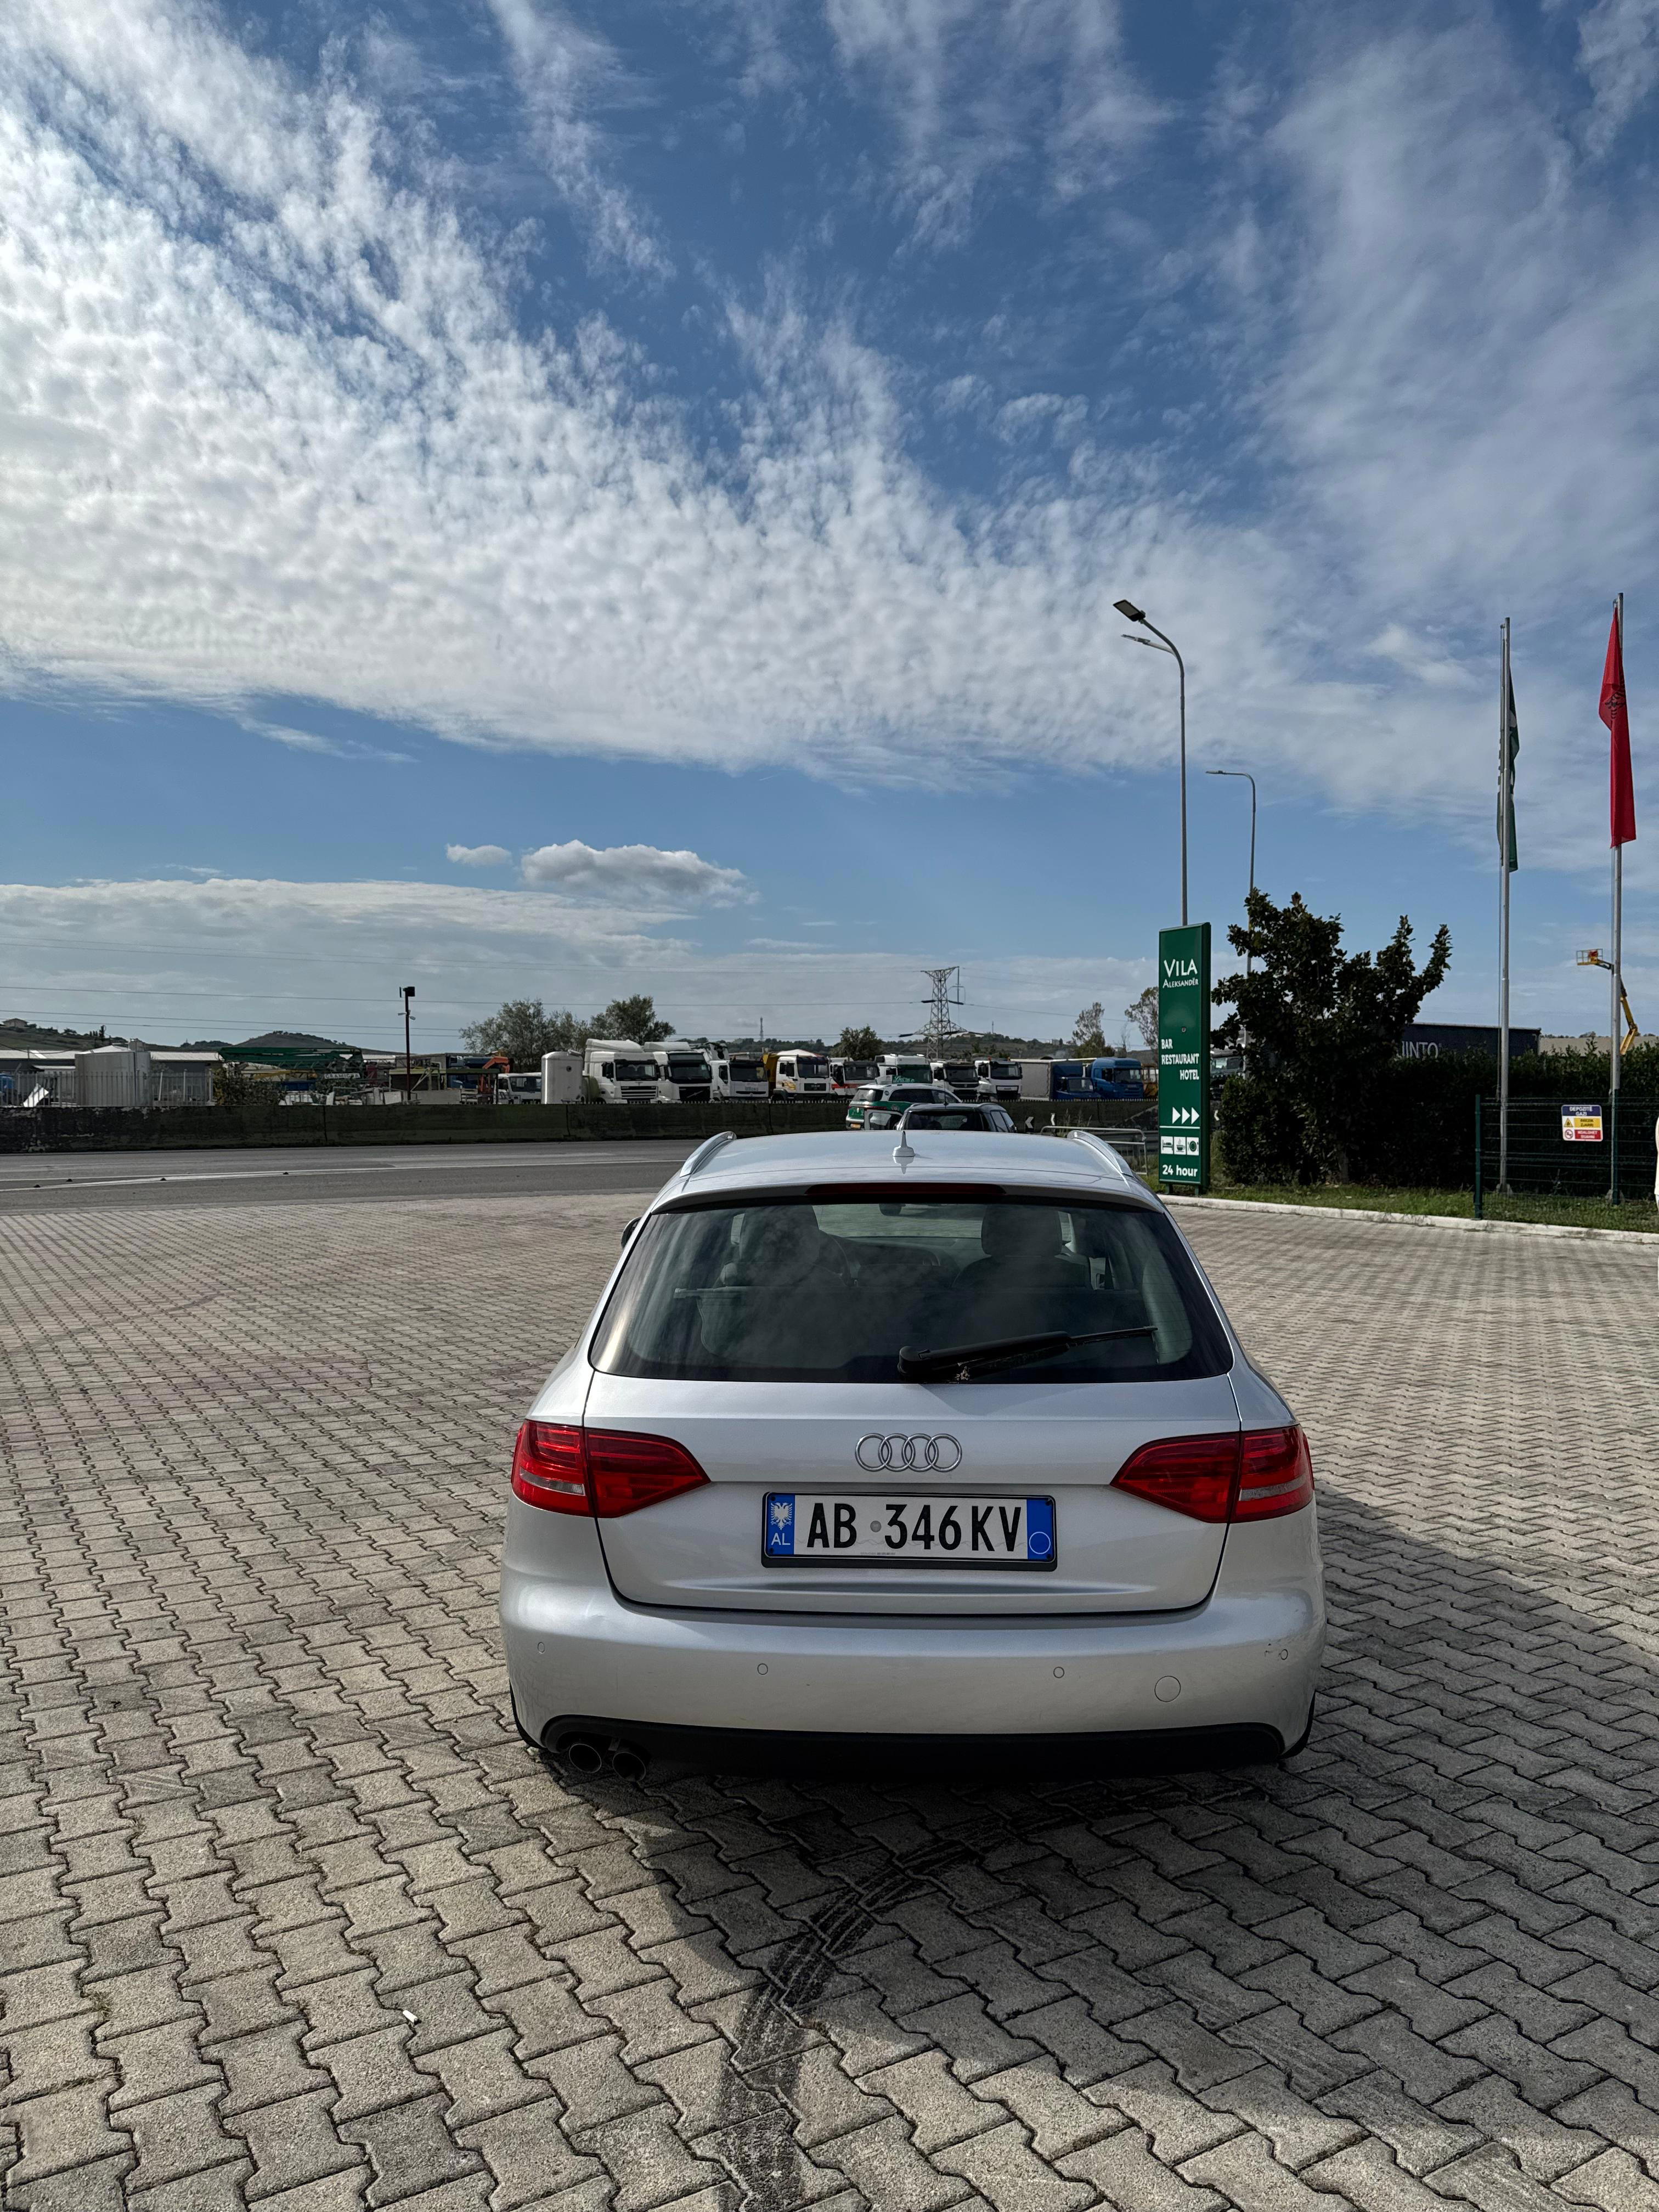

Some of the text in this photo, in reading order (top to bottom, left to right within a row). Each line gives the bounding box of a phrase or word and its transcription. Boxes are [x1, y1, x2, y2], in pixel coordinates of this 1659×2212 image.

[1164, 958, 1198, 978] VILA
[1161, 1039, 1173, 1049] BAR
[1161, 1053, 1200, 1065] RESTAURANT
[1180, 1069, 1200, 1080] HOTEL
[1162, 1164, 1198, 1177] 24 hour
[806, 1503, 857, 1549] AB
[771, 1532, 791, 1545] AL
